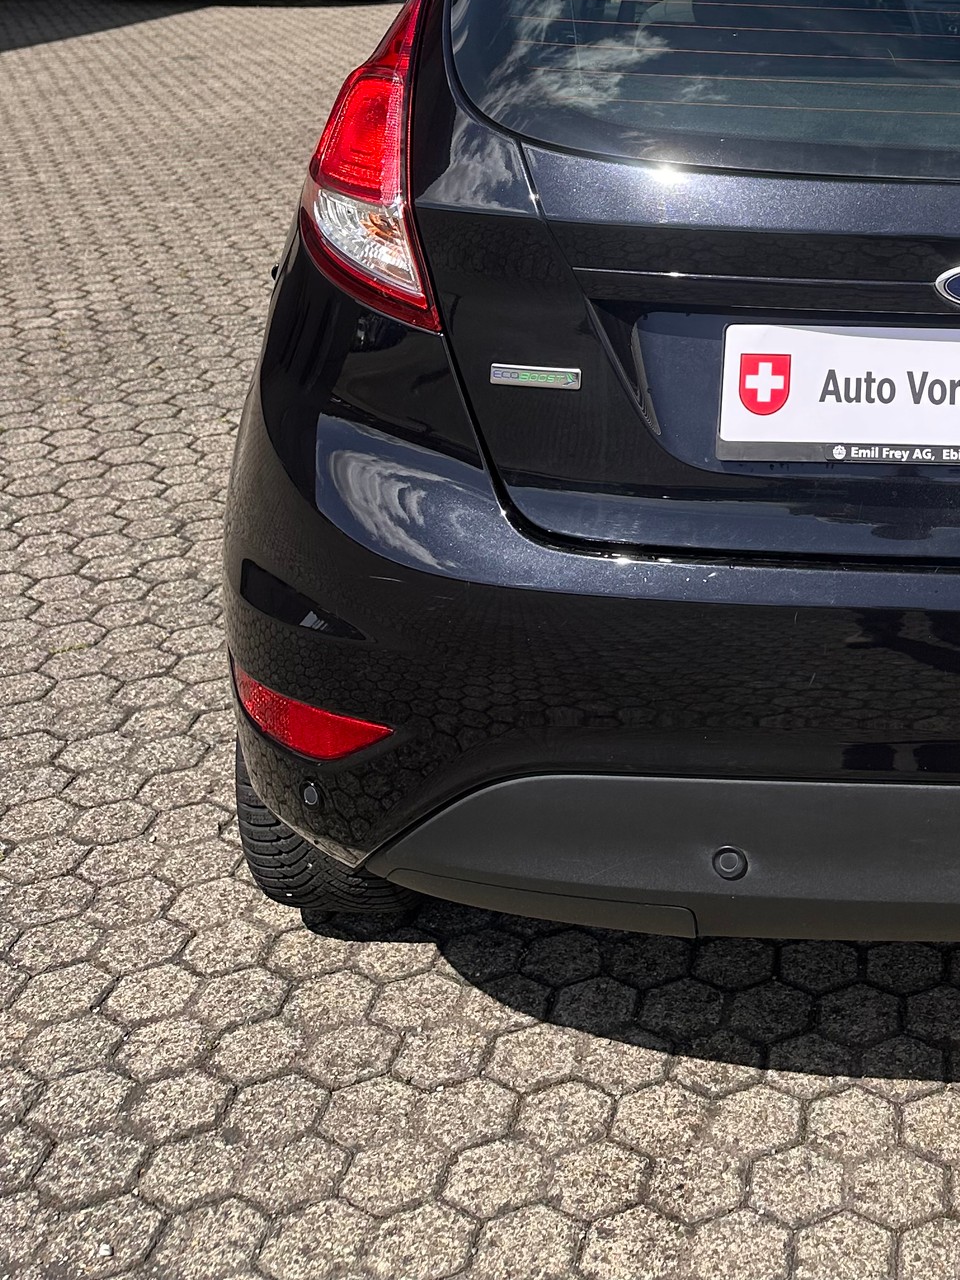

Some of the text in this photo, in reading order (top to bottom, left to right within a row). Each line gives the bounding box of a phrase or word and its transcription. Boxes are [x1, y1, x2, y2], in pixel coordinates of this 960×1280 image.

[819, 369, 896, 404] Auto
[850, 446, 879, 459] Emil
[882, 447, 909, 462] Frey
[912, 448, 935, 461] AG,
